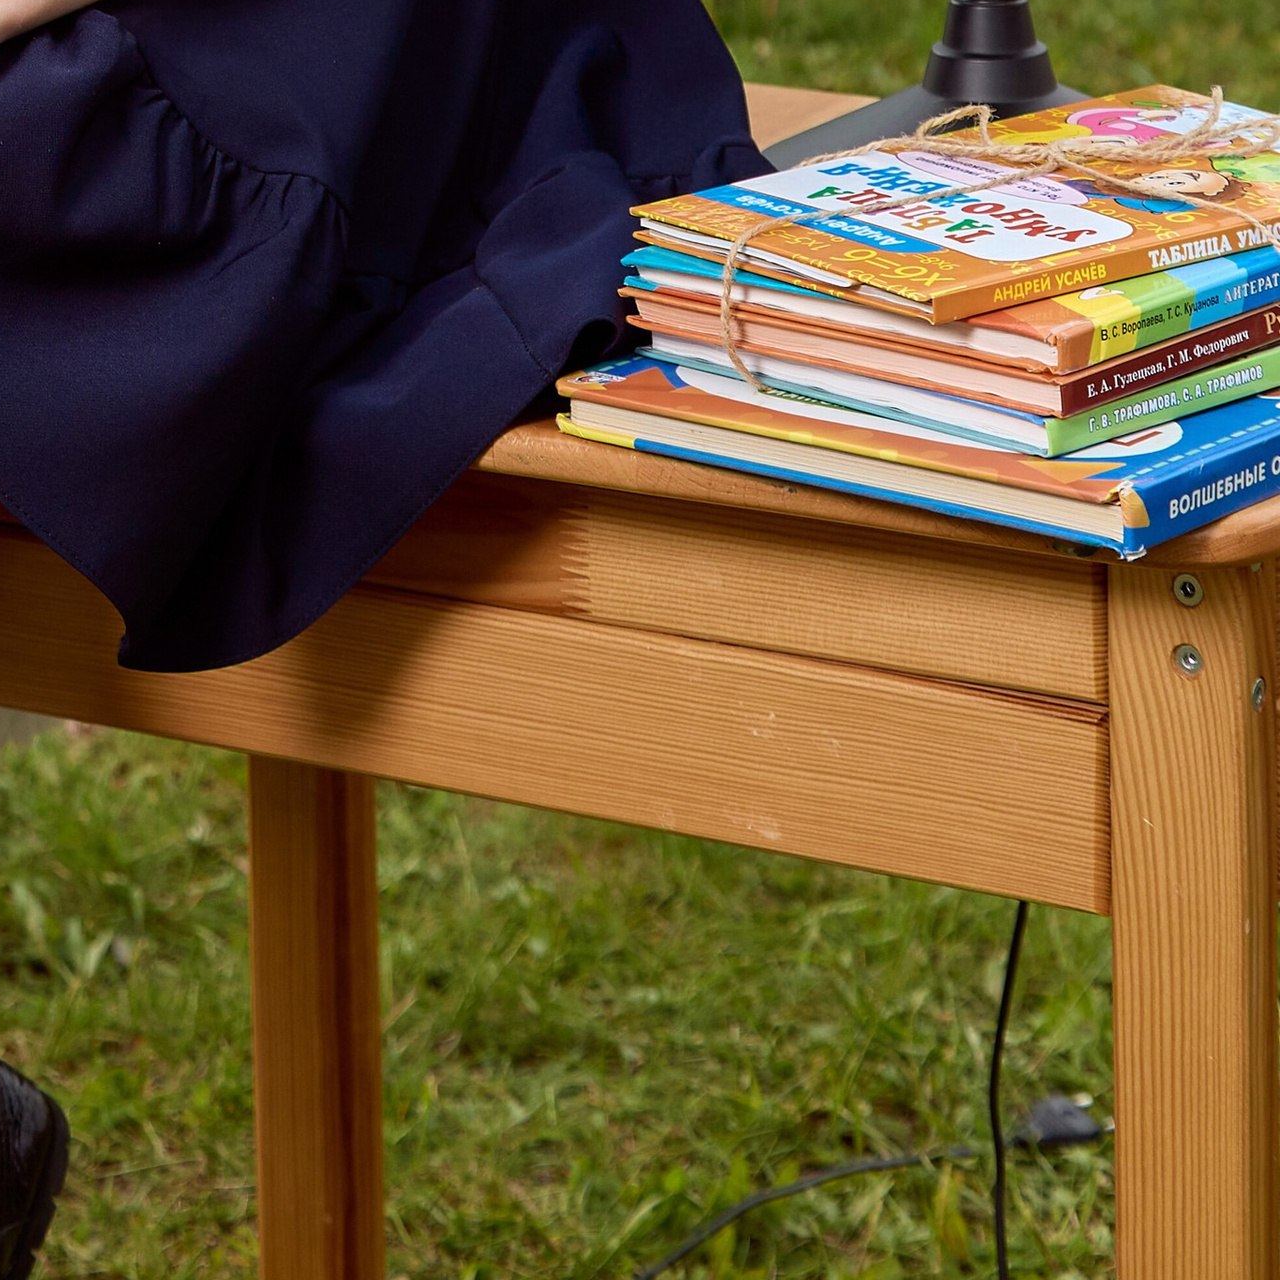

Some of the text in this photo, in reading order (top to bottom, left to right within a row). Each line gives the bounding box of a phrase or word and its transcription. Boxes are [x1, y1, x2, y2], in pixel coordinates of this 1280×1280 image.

[735, 194, 805, 216] сачёв
[994, 273, 1051, 302] АНДРЕЙ
[1057, 263, 1107, 290] УСАЧЁВ
[1148, 240, 1232, 269] ТАБЛИЦА
[1100, 329, 1111, 341] В.
[1112, 326, 1121, 338] С.
[1121, 313, 1166, 335] Воропаева,
[1166, 308, 1173, 320] Т.
[1174, 305, 1182, 317] С.
[1087, 384, 1098, 398] Е.
[1100, 379, 1112, 393] А.
[1113, 359, 1166, 389] Гулецкая,
[1167, 355, 1178, 368] Г.
[1179, 350, 1192, 364] М.
[1193, 329, 1250, 358] Федорович
[1089, 365, 1264, 432] Г. В. ТРАФИМОВА, С. А. ТРАФИМОВ
[1169, 461, 1266, 520] ВОЛШЕБНЫЕ
